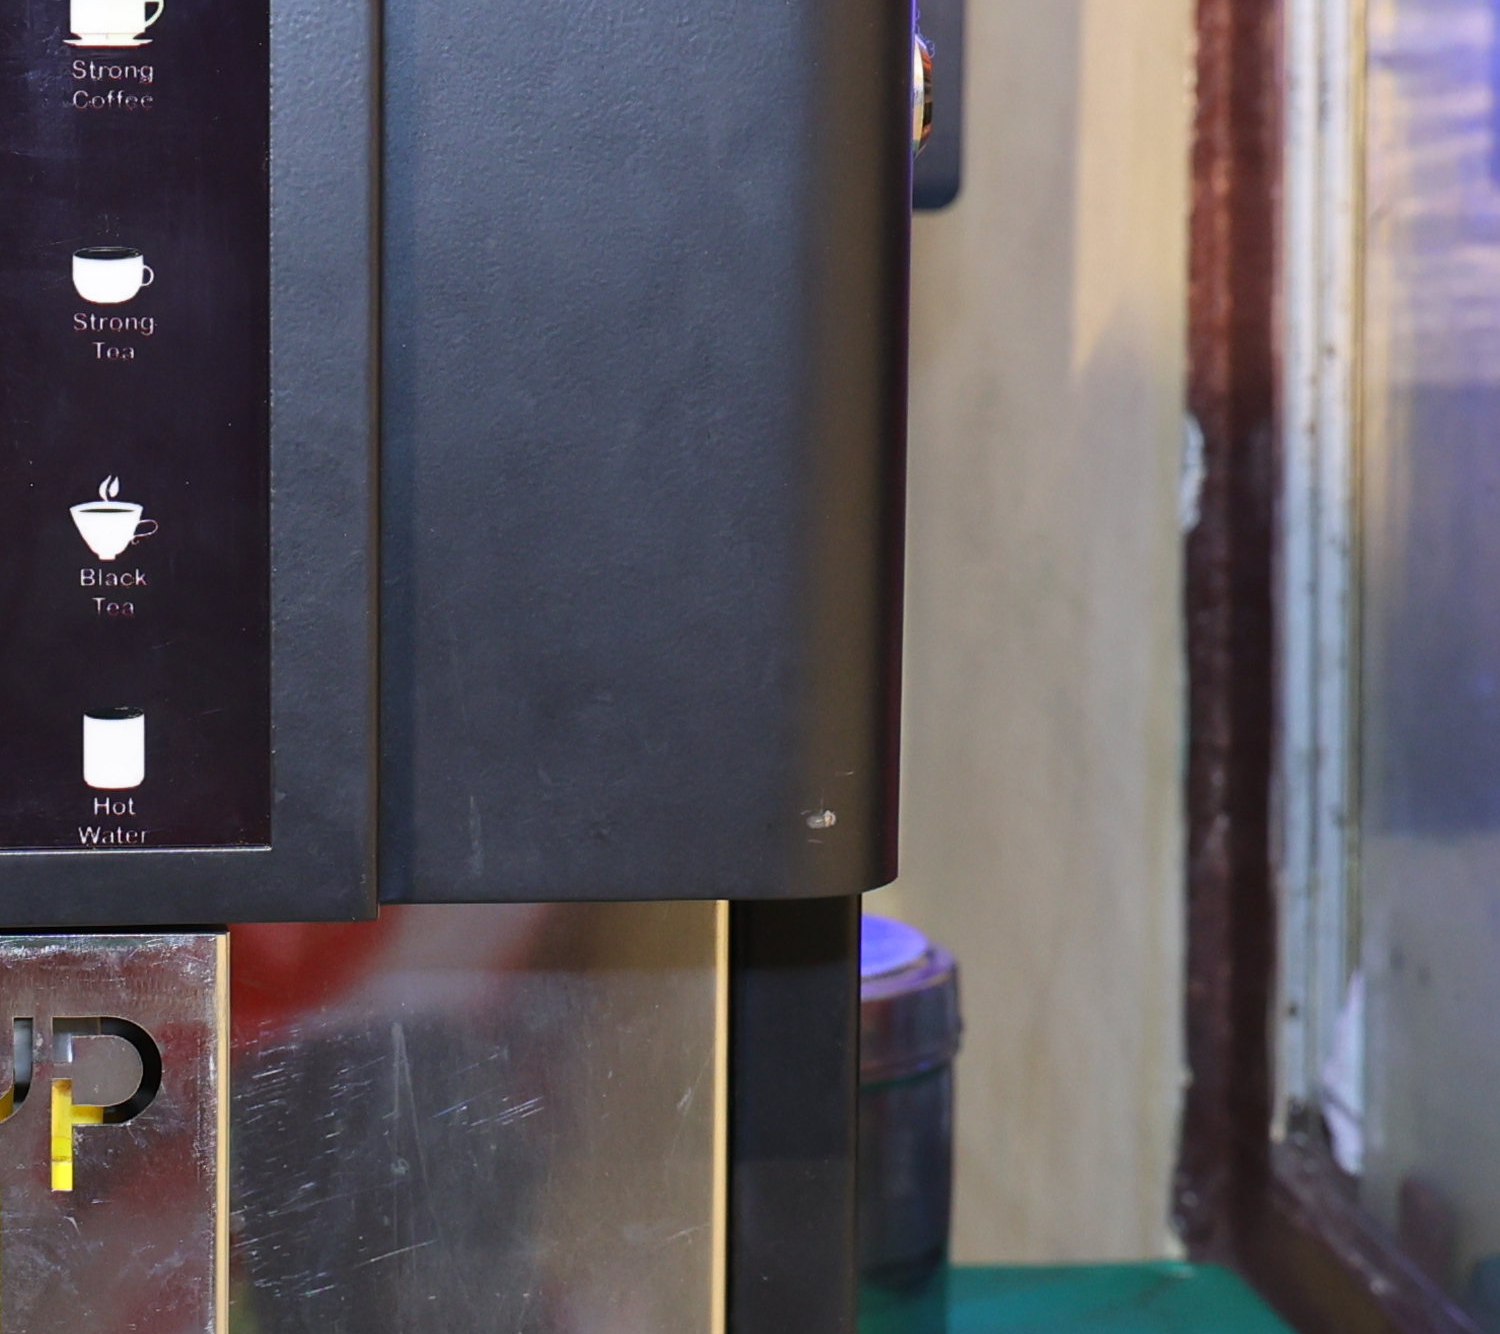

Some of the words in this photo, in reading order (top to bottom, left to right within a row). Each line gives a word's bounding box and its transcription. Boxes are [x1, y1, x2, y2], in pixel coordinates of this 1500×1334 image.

[71, 59, 154, 84] Strong
[71, 89, 154, 110] Coffee
[73, 312, 155, 336] Strong
[92, 341, 135, 360] Tea
[80, 568, 147, 587] Black
[92, 597, 135, 617] Tea
[93, 796, 136, 816] Hot
[78, 826, 147, 845] Water
